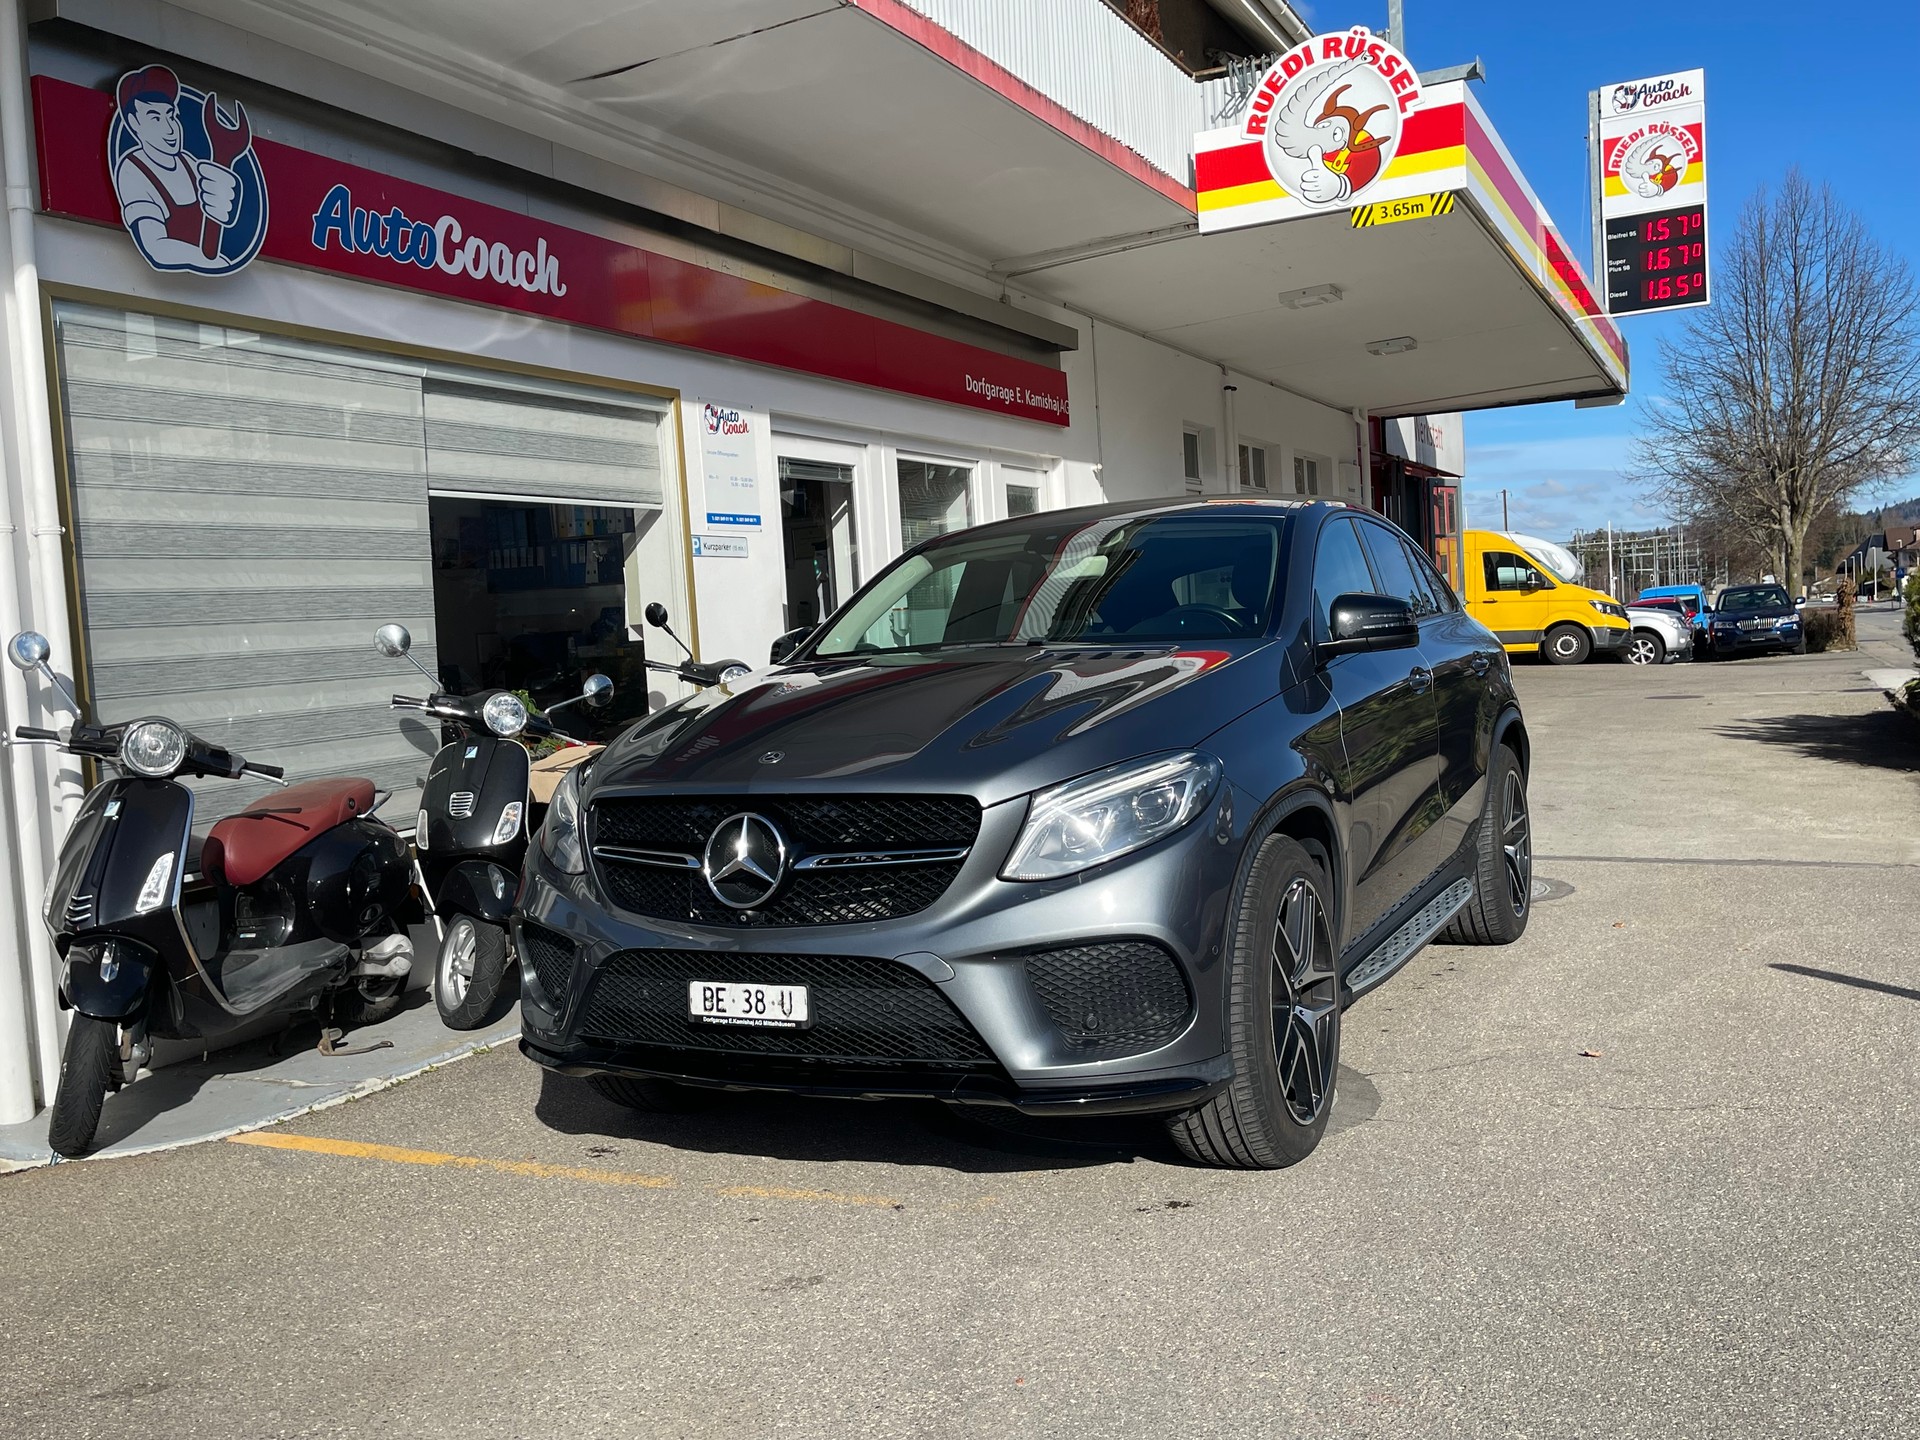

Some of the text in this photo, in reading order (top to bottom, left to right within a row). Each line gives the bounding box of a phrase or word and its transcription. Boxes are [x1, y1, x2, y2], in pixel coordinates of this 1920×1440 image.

[1246, 29, 1421, 135] RUEDI RÜSSEL
[1637, 80, 1674, 99] Auto
[1643, 83, 1692, 107] Coach
[1611, 121, 1697, 169] RUEDI RÜSSEL
[1380, 202, 1424, 219] 3.65m
[1607, 231, 1629, 240] Bleifrei
[1608, 259, 1626, 267] Super
[965, 374, 1015, 405] Dorfgarage
[1016, 387, 1024, 403] E.
[1025, 389, 1060, 416] Kamishaj
[719, 408, 739, 424] Auto
[722, 418, 750, 435] Coach
[703, 542, 731, 552] Kurzparker
[703, 986, 792, 1017] BE 38 U
